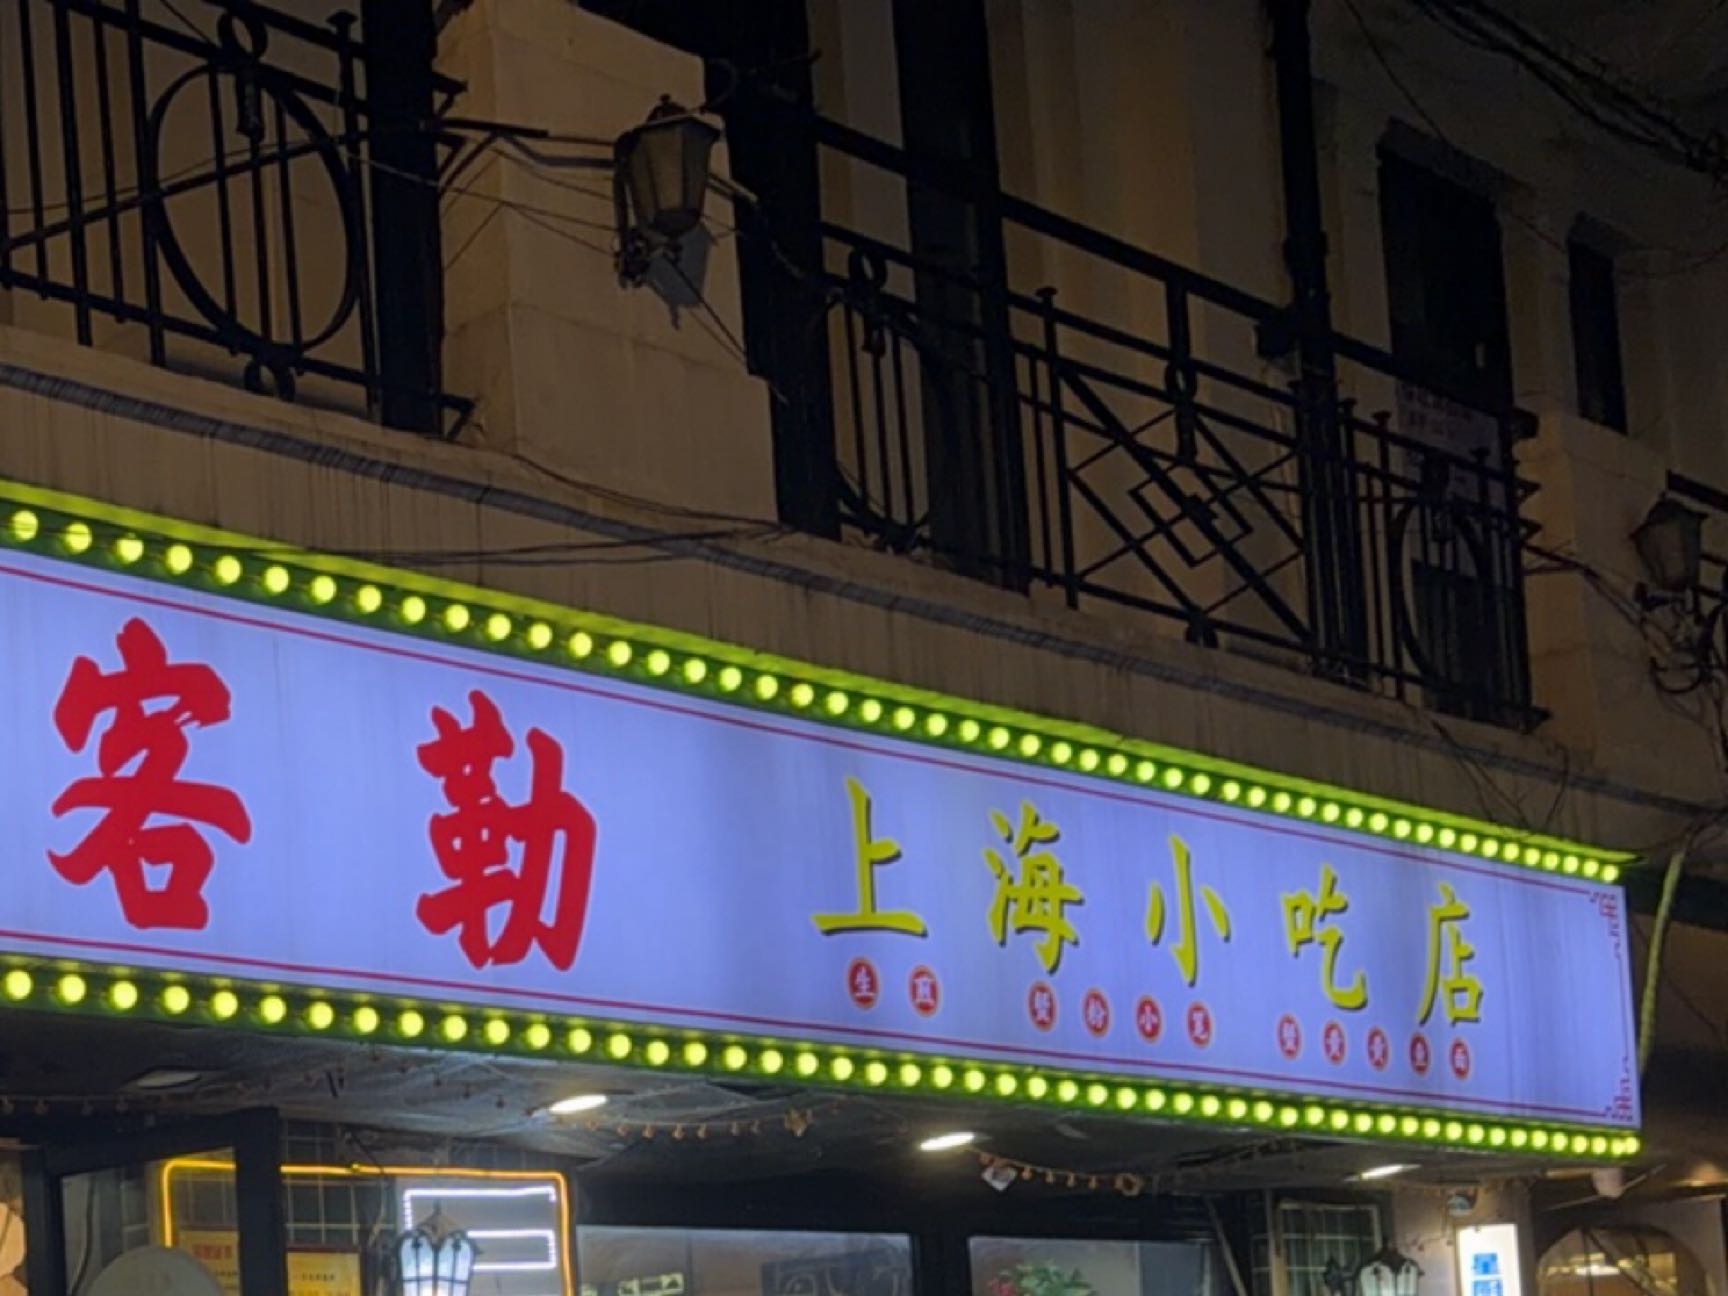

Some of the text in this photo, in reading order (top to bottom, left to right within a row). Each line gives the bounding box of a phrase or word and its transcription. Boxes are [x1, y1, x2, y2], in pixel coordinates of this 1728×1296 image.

[811, 775, 1485, 1028] 上海小吃店
